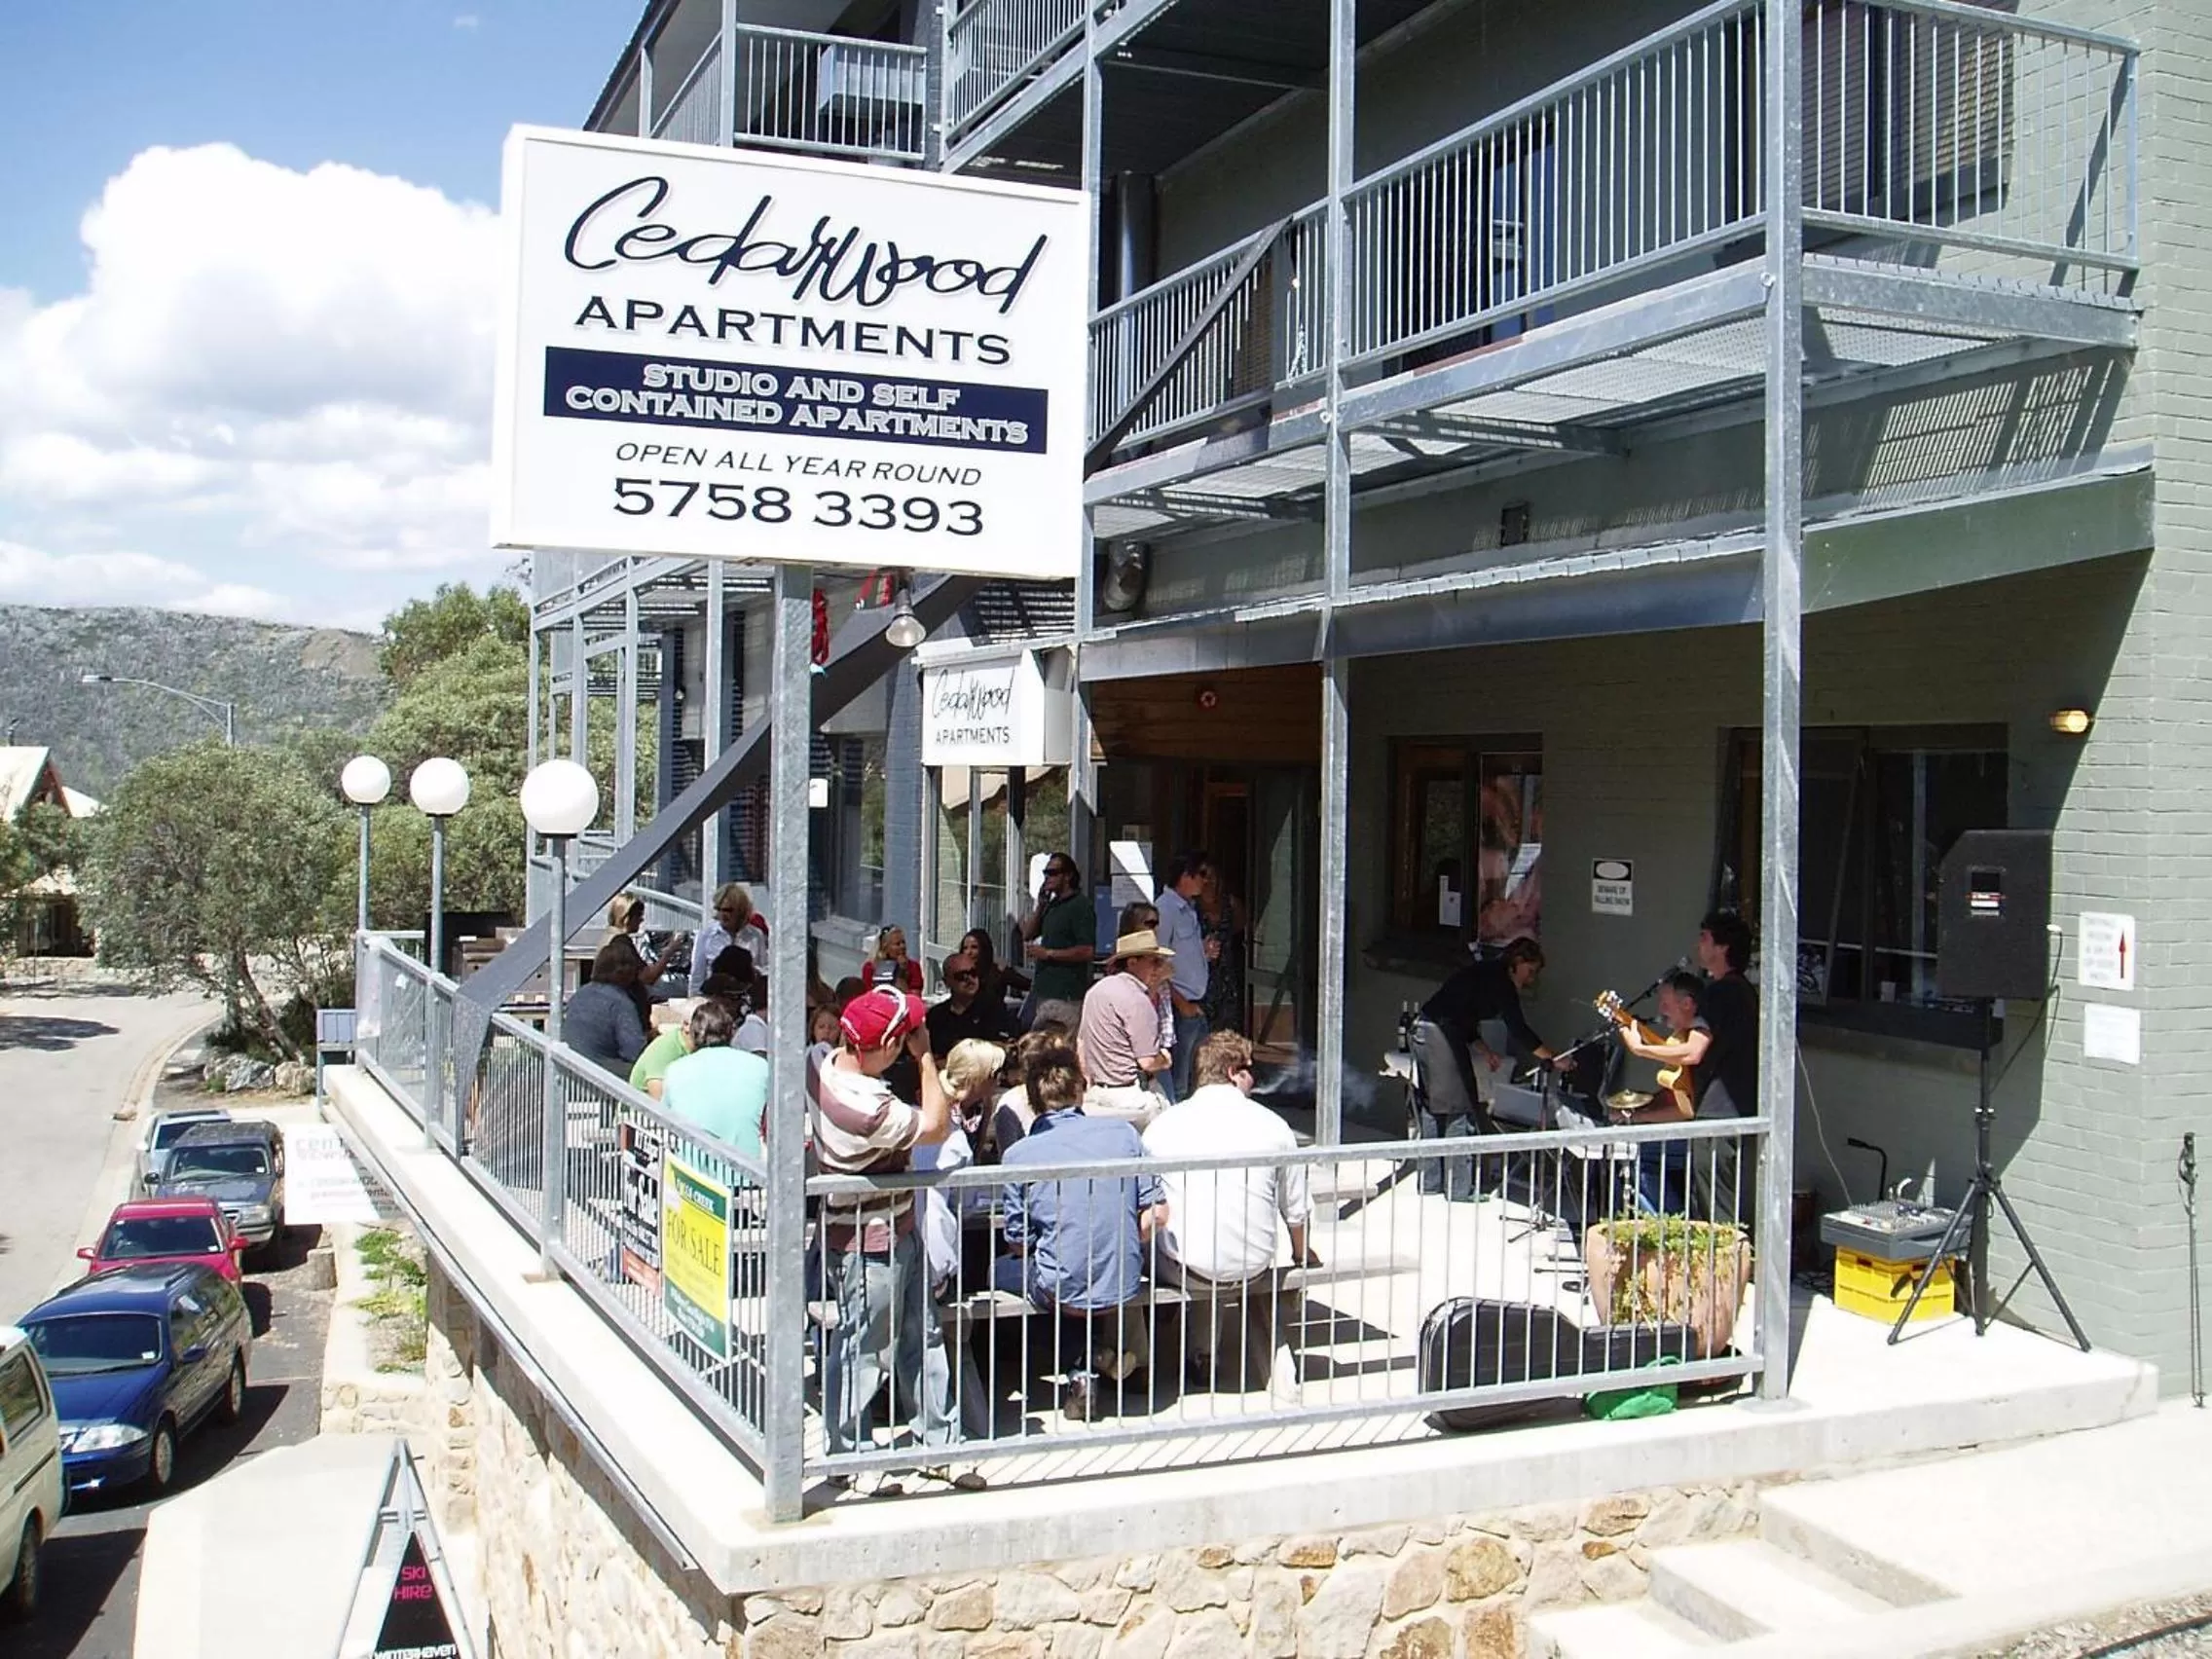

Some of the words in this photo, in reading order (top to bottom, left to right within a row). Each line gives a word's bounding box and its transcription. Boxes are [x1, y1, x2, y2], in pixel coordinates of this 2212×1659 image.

[574, 295, 1011, 365] APARTMENTS
[644, 363, 778, 397] STUDIO
[785, 376, 865, 403] AND
[872, 383, 961, 412] SELF
[565, 386, 784, 424] CONTAINED
[789, 404, 1029, 445] APARTMENTS
[615, 442, 708, 466] OPEN
[715, 451, 774, 472] ALL
[786, 455, 866, 478] YEAR
[872, 461, 981, 486] ROUND
[612, 477, 793, 524] 5758
[813, 490, 984, 536] 3393
[936, 726, 1011, 744] APARTMENTS
[666, 1209, 687, 1255] FOR
[690, 1224, 721, 1276] SALE
[401, 1566, 426, 1581] SKI
